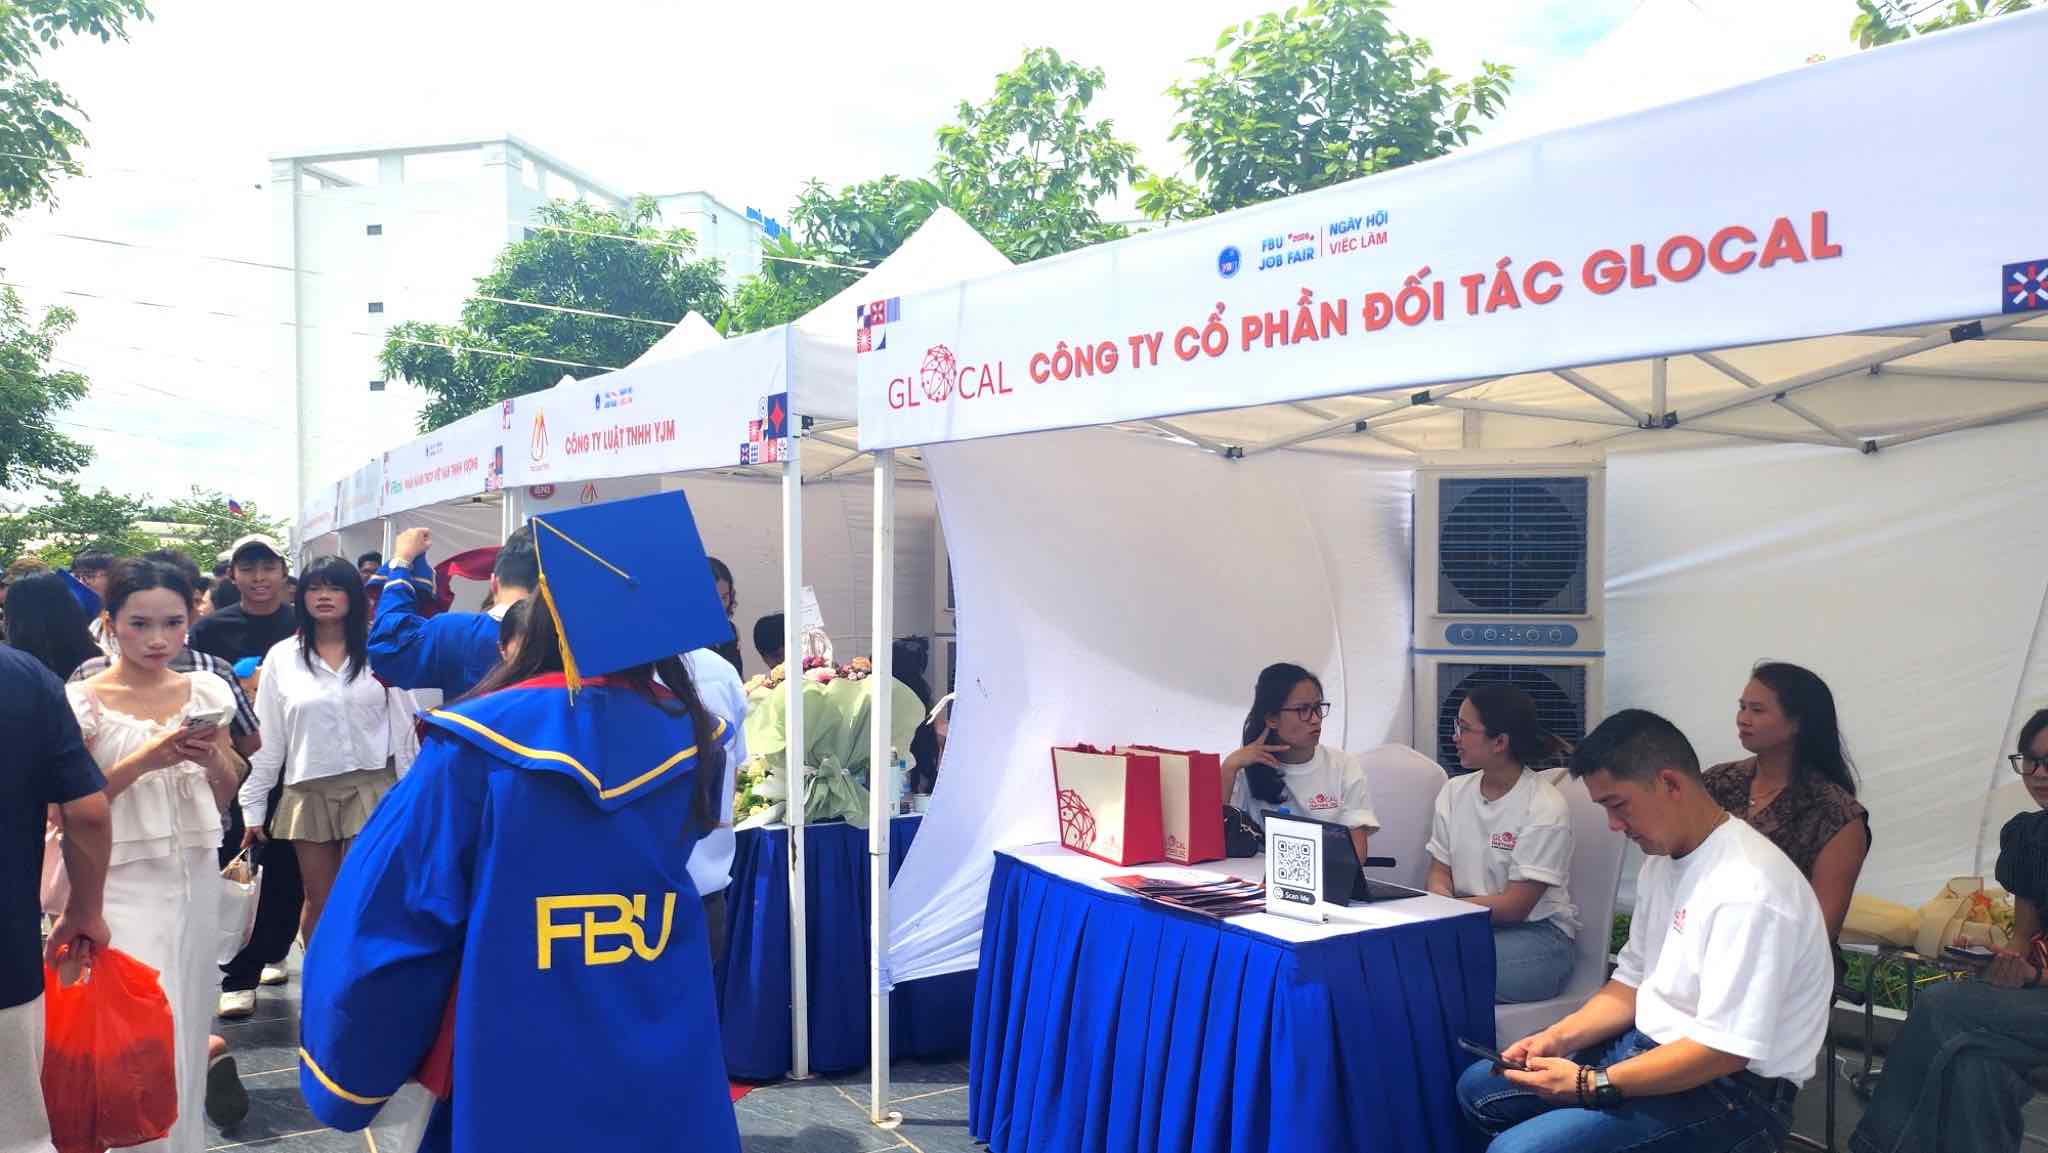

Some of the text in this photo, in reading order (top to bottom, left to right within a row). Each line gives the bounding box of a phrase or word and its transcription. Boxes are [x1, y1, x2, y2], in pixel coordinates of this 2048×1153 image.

[1329, 210, 1388, 236] NGÀY HỘI
[1262, 236, 1283, 253] FBU
[1361, 231, 1388, 248] LÀM
[1259, 254, 1283, 271] JOB
[1288, 247, 1315, 265] FAIR
[1029, 211, 1842, 384] CÔNG TY CỔ PHẦN ĐỐI TÁC GLOCAL
[565, 419, 676, 455] CÔNG TY LUẬT TNHH YJM
[536, 892, 677, 969] FBU
